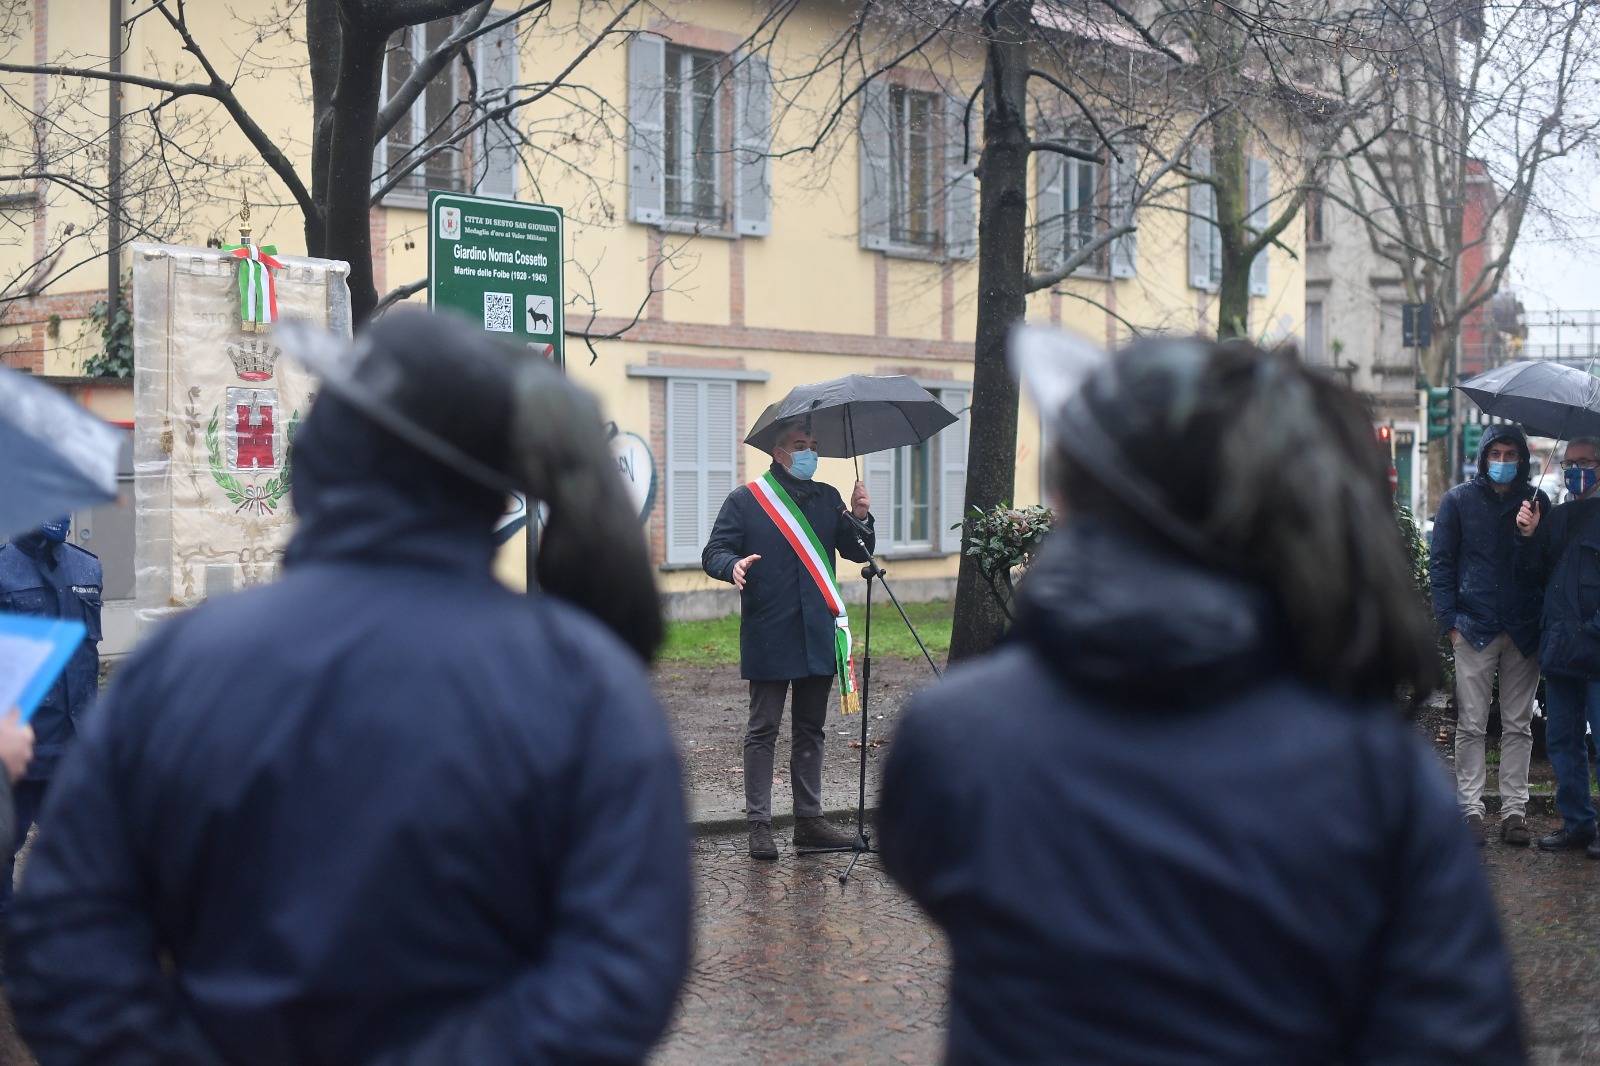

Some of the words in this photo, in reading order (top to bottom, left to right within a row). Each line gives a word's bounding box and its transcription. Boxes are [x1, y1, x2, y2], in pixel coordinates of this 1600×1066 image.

[464, 227, 489, 236] Medaglia
[494, 219, 514, 228] SESTO
[515, 221, 527, 229] SAN
[528, 222, 556, 232] GIOVANNI
[454, 244, 486, 261] Giardino
[488, 248, 513, 263] Norma
[515, 250, 548, 267] Cossetto
[454, 266, 475, 276] Martire
[477, 268, 491, 277] delle
[493, 269, 510, 279] Foibe
[511, 271, 527, 281] (1920
[532, 273, 548, 284] 1943)
